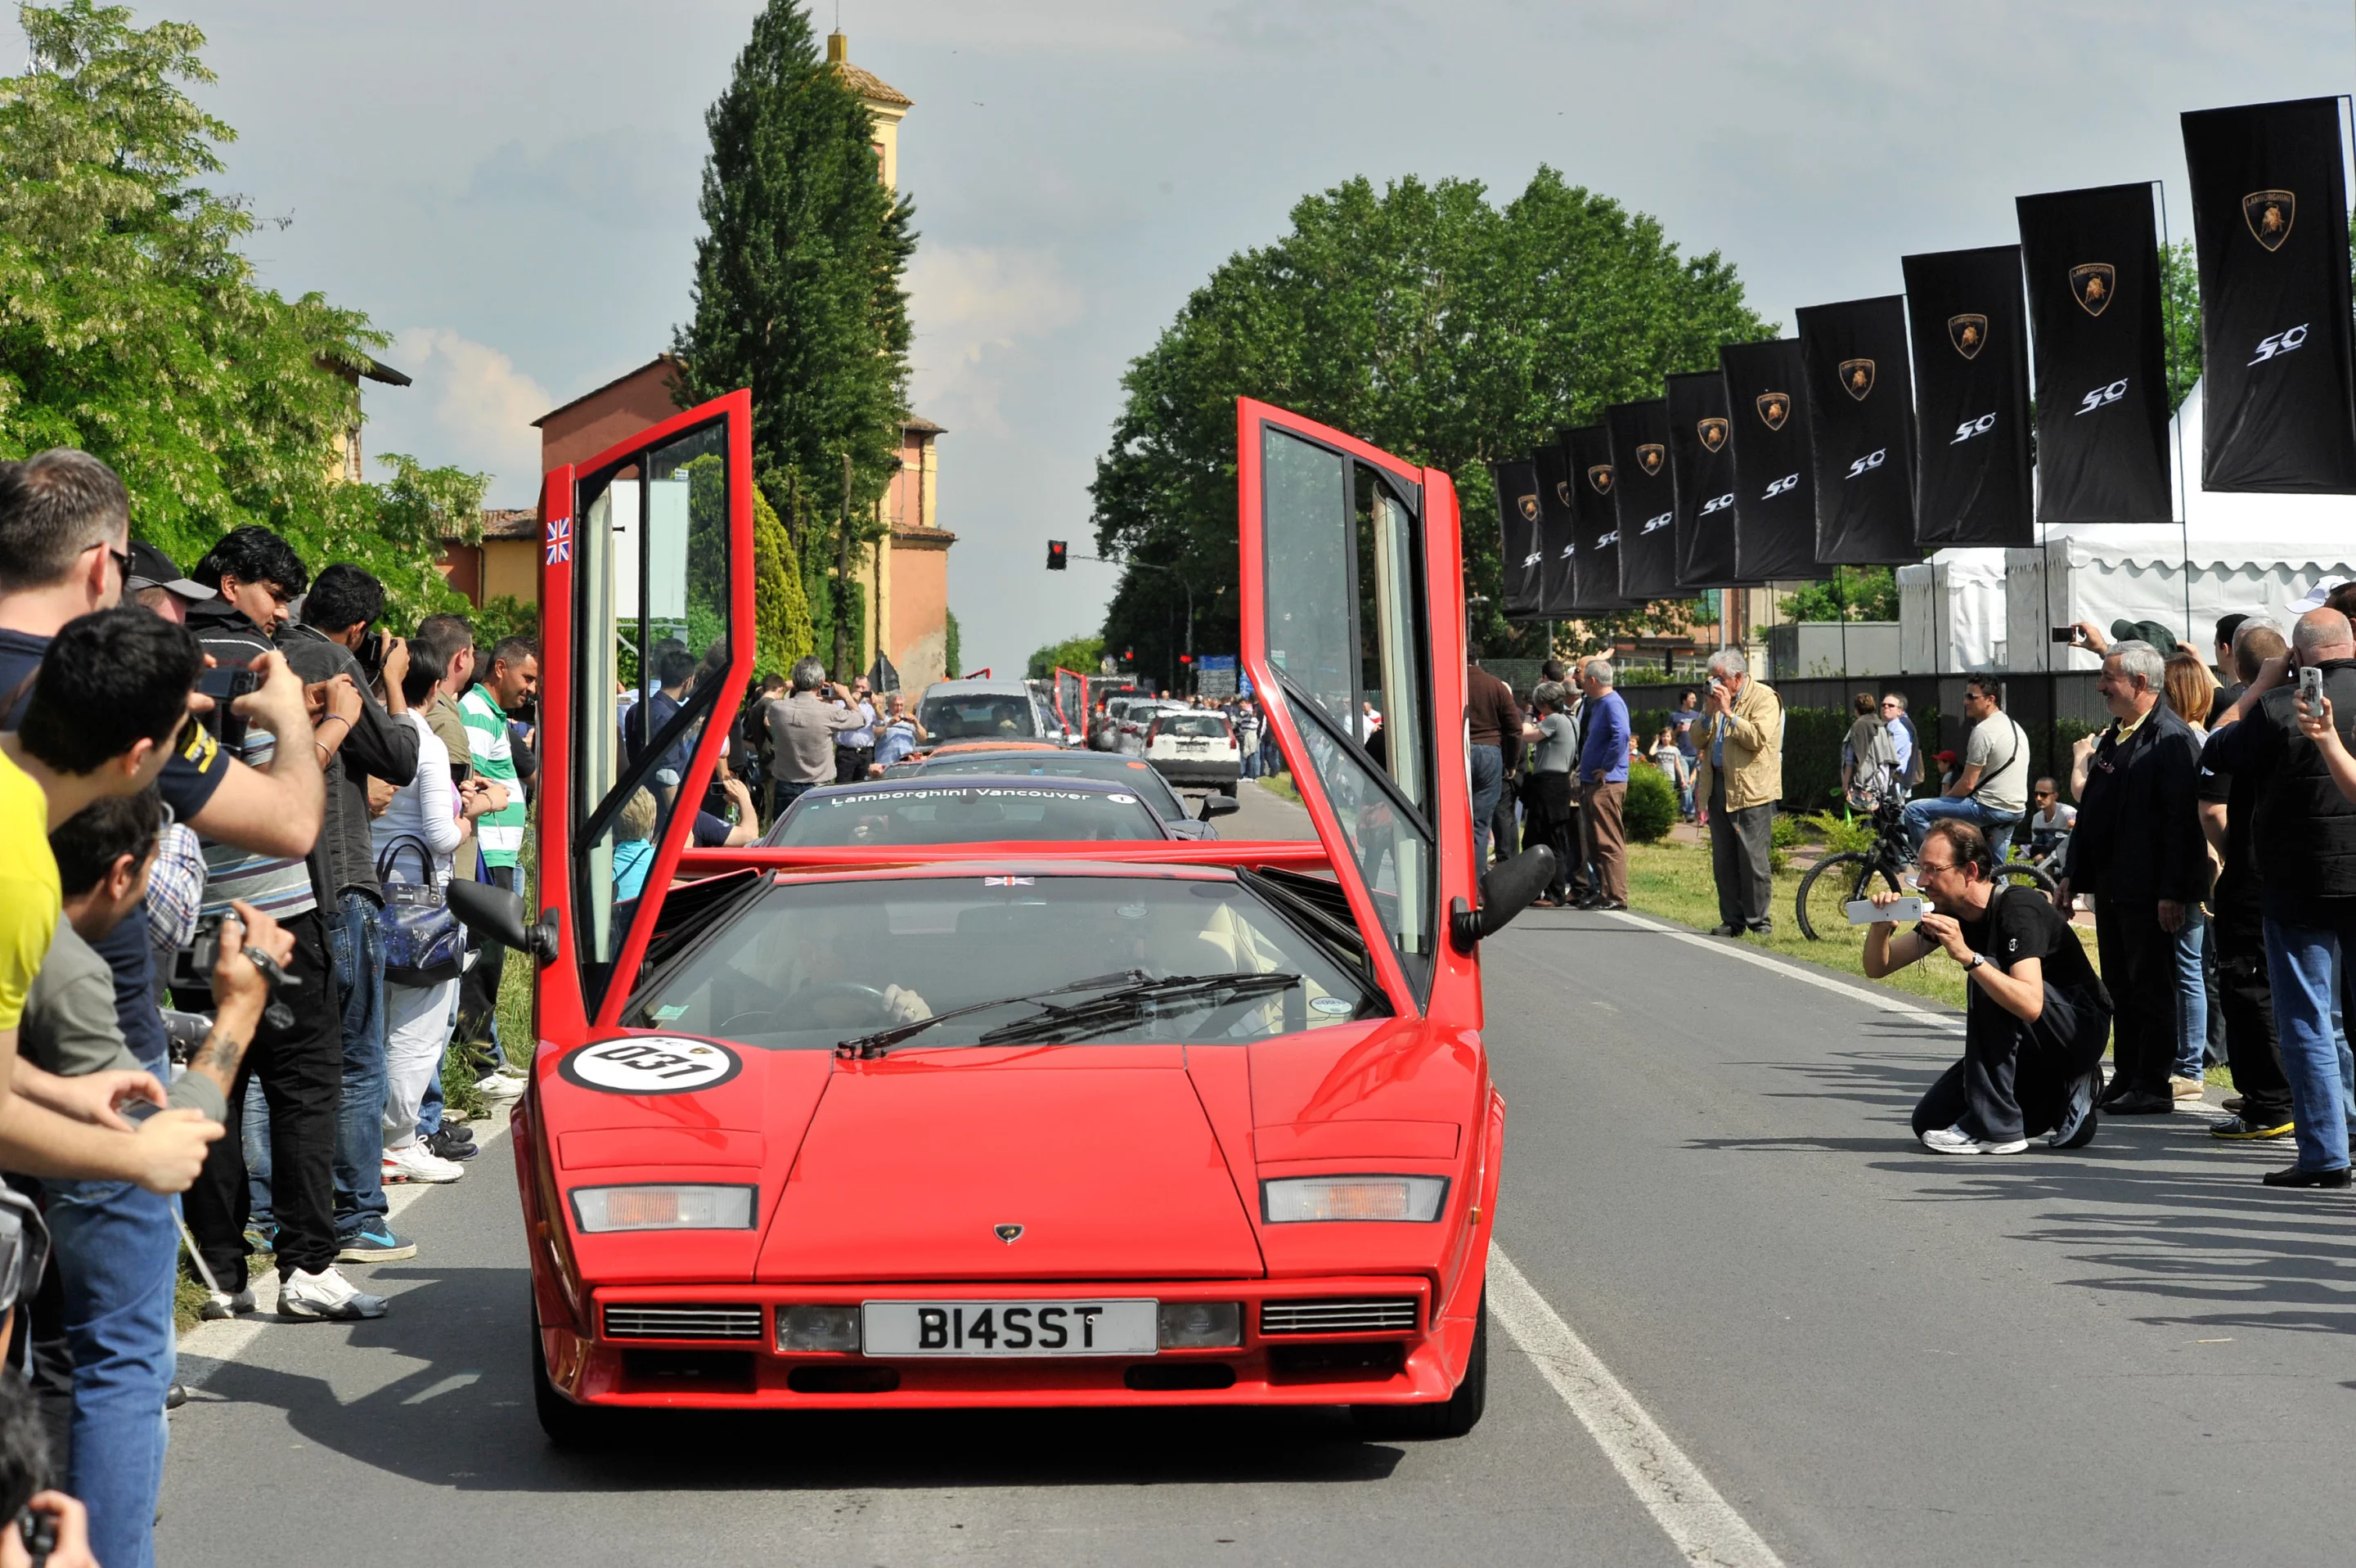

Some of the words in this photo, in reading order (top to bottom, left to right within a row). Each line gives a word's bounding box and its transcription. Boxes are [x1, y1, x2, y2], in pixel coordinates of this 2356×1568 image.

[2246, 193, 2291, 207] LAMBORGHINI
[831, 788, 967, 806] Lamborghini
[975, 788, 1090, 801] Vancouver
[589, 1045, 714, 1079] 031
